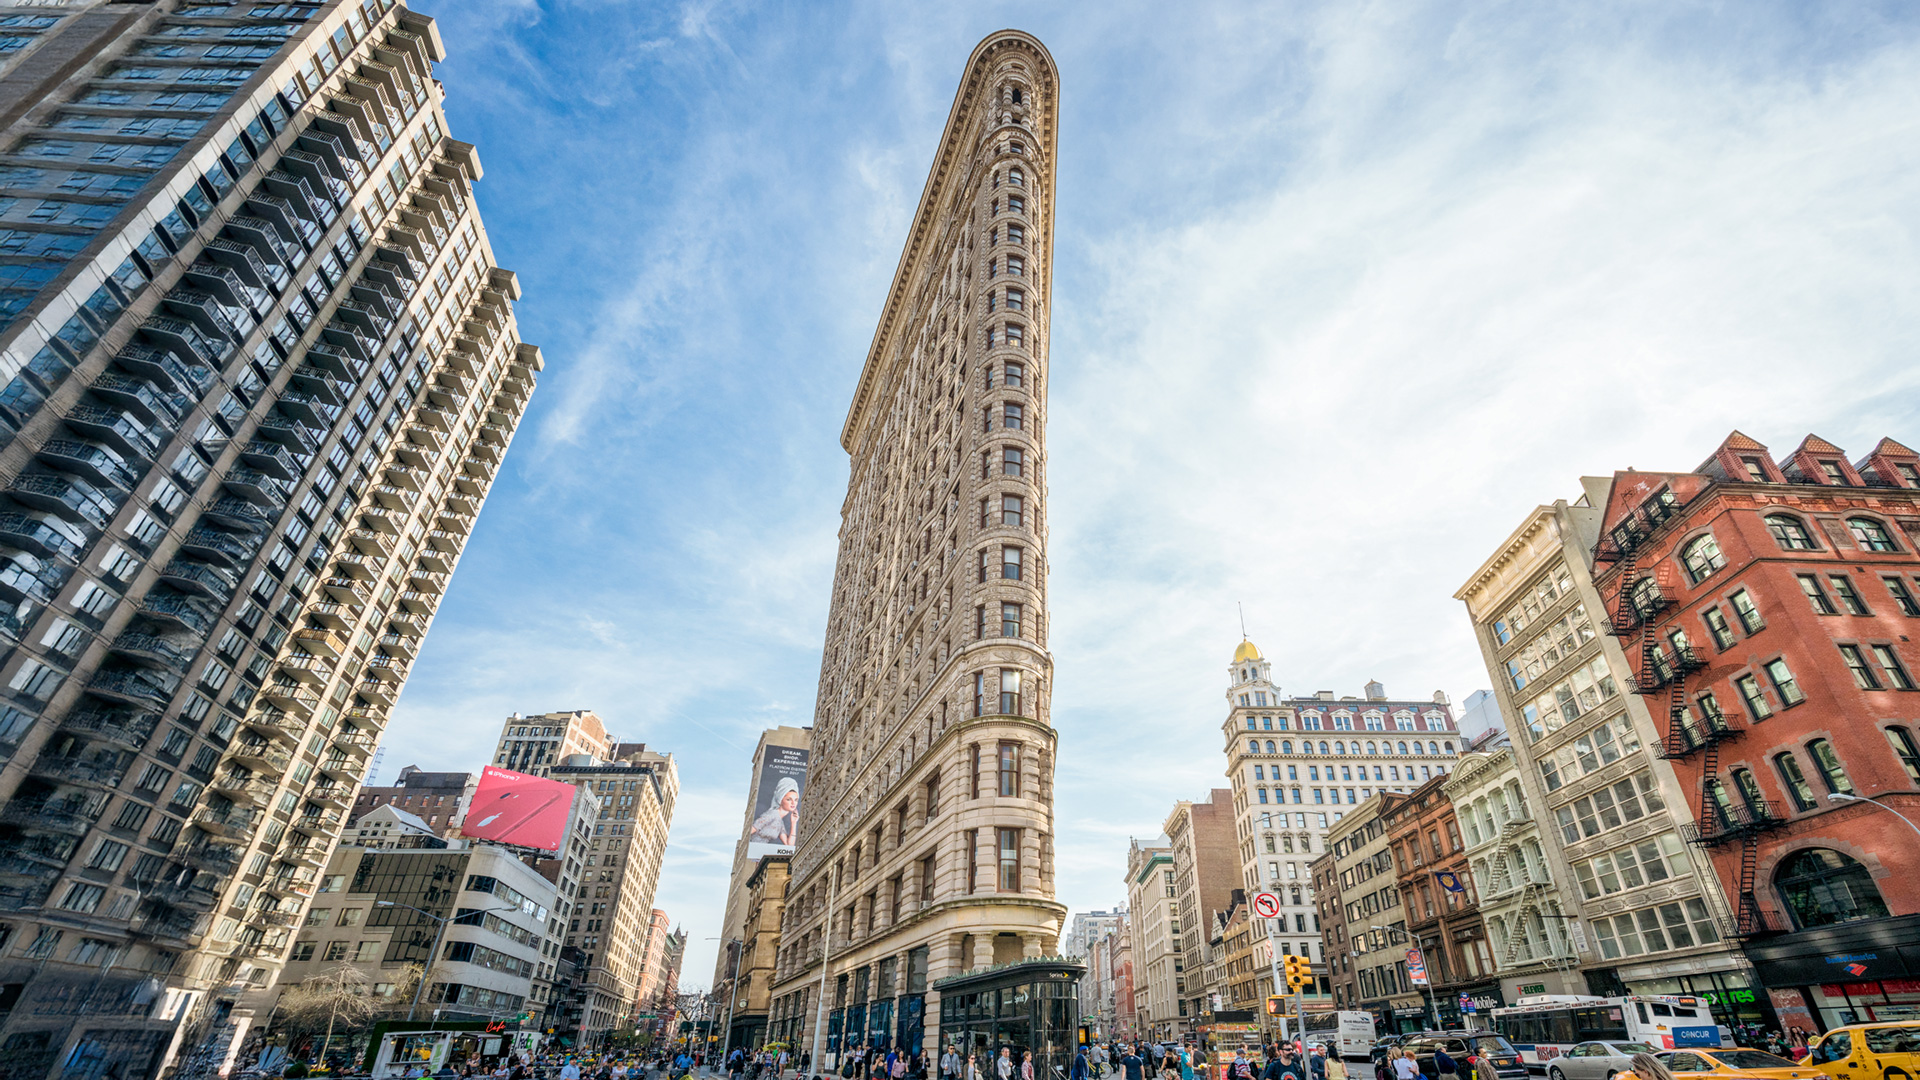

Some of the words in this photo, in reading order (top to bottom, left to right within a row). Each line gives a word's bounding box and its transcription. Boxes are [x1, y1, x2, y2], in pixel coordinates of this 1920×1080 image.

[493, 770, 515, 781] iPhone
[1049, 971, 1063, 979] Sprint
[486, 1020, 506, 1032] Cafe
[1681, 1030, 1710, 1039] CONCUR
[519, 1032, 535, 1049] FedEx
